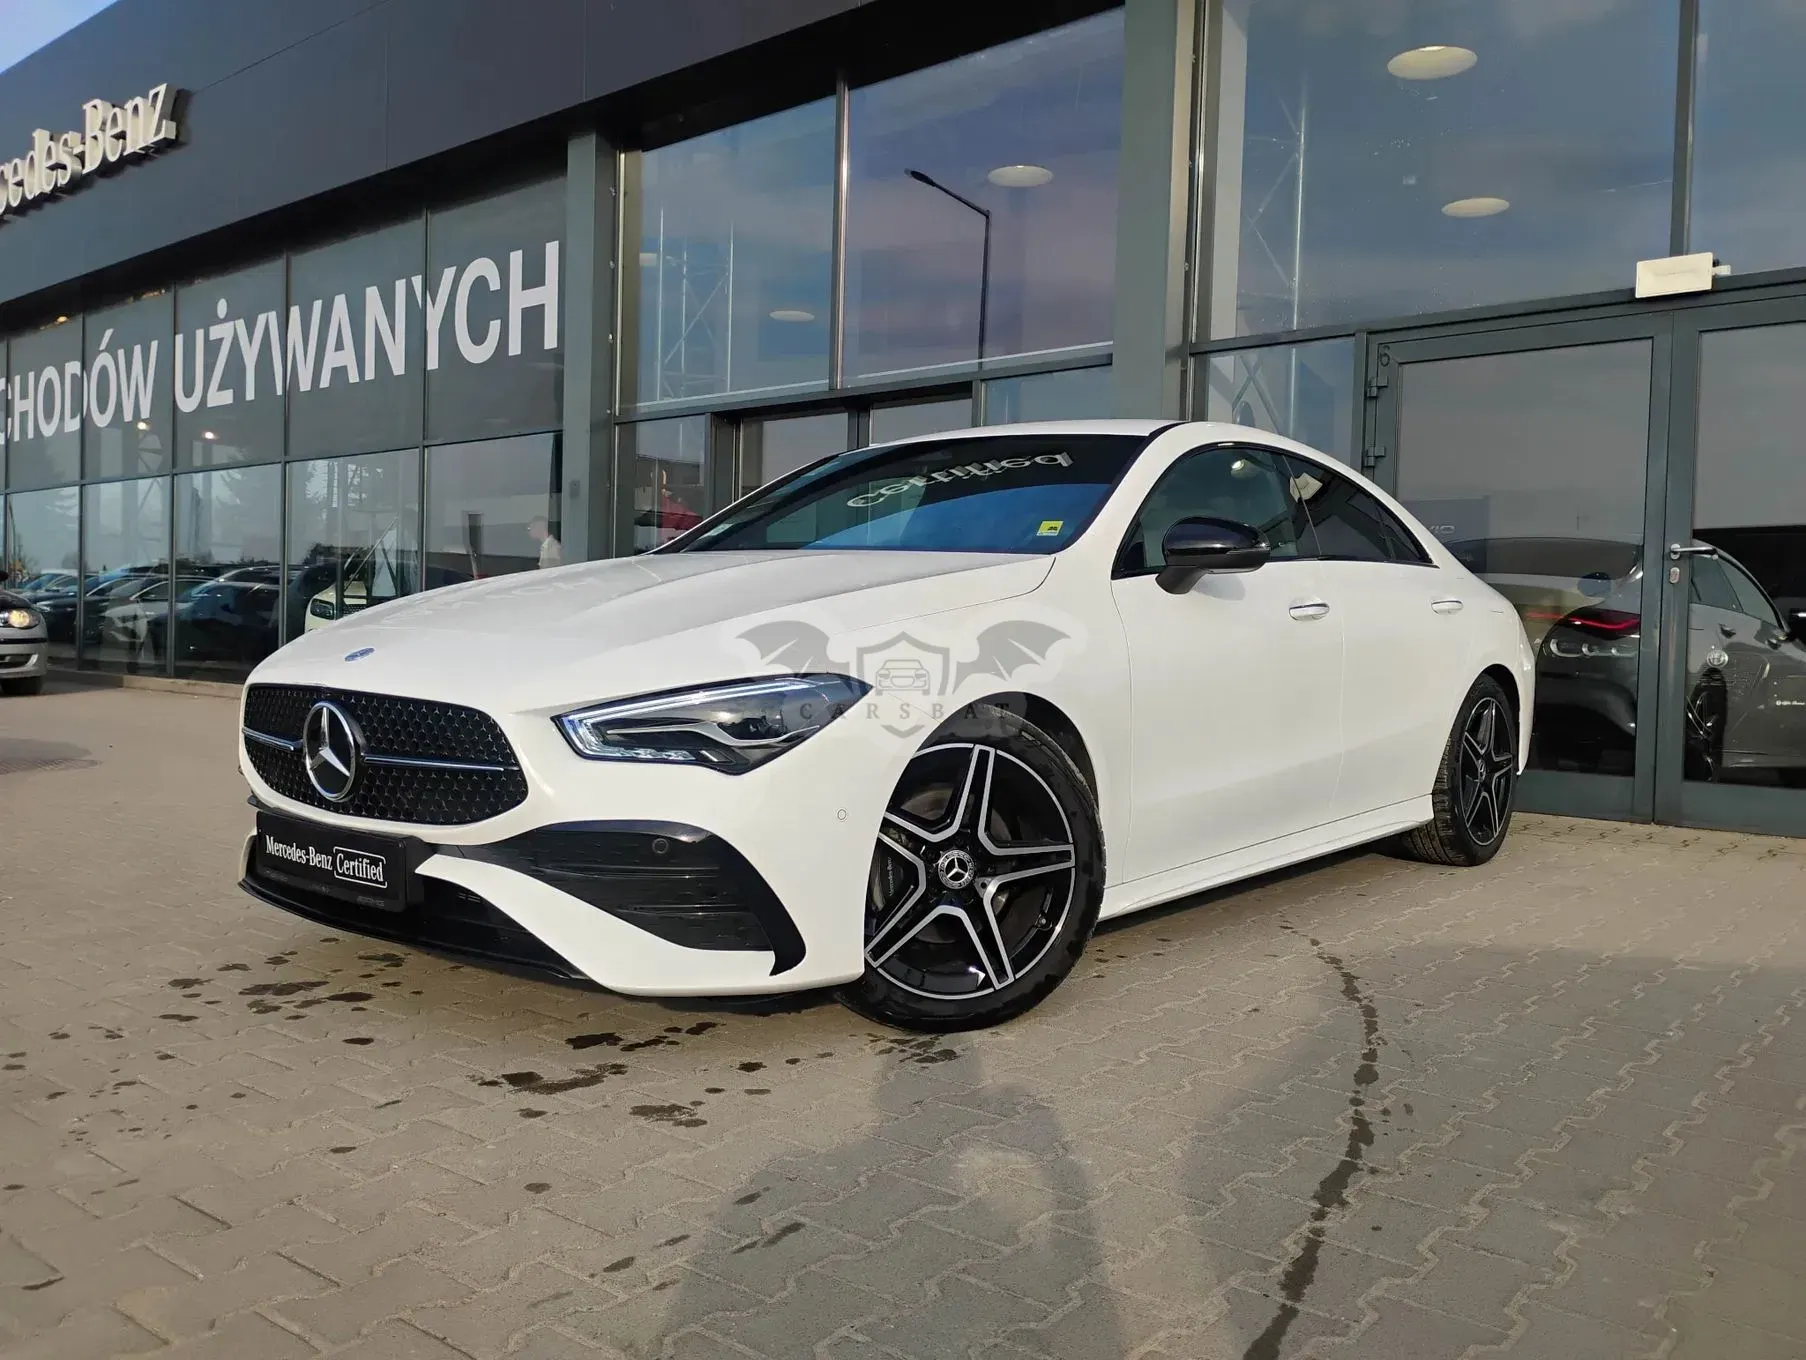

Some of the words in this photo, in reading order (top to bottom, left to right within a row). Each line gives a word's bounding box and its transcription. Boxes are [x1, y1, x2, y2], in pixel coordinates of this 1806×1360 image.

[175, 240, 560, 413] UŻYWANYCH
[265, 835, 333, 871] Mercedes-Benz
[336, 853, 384, 881] Certified
